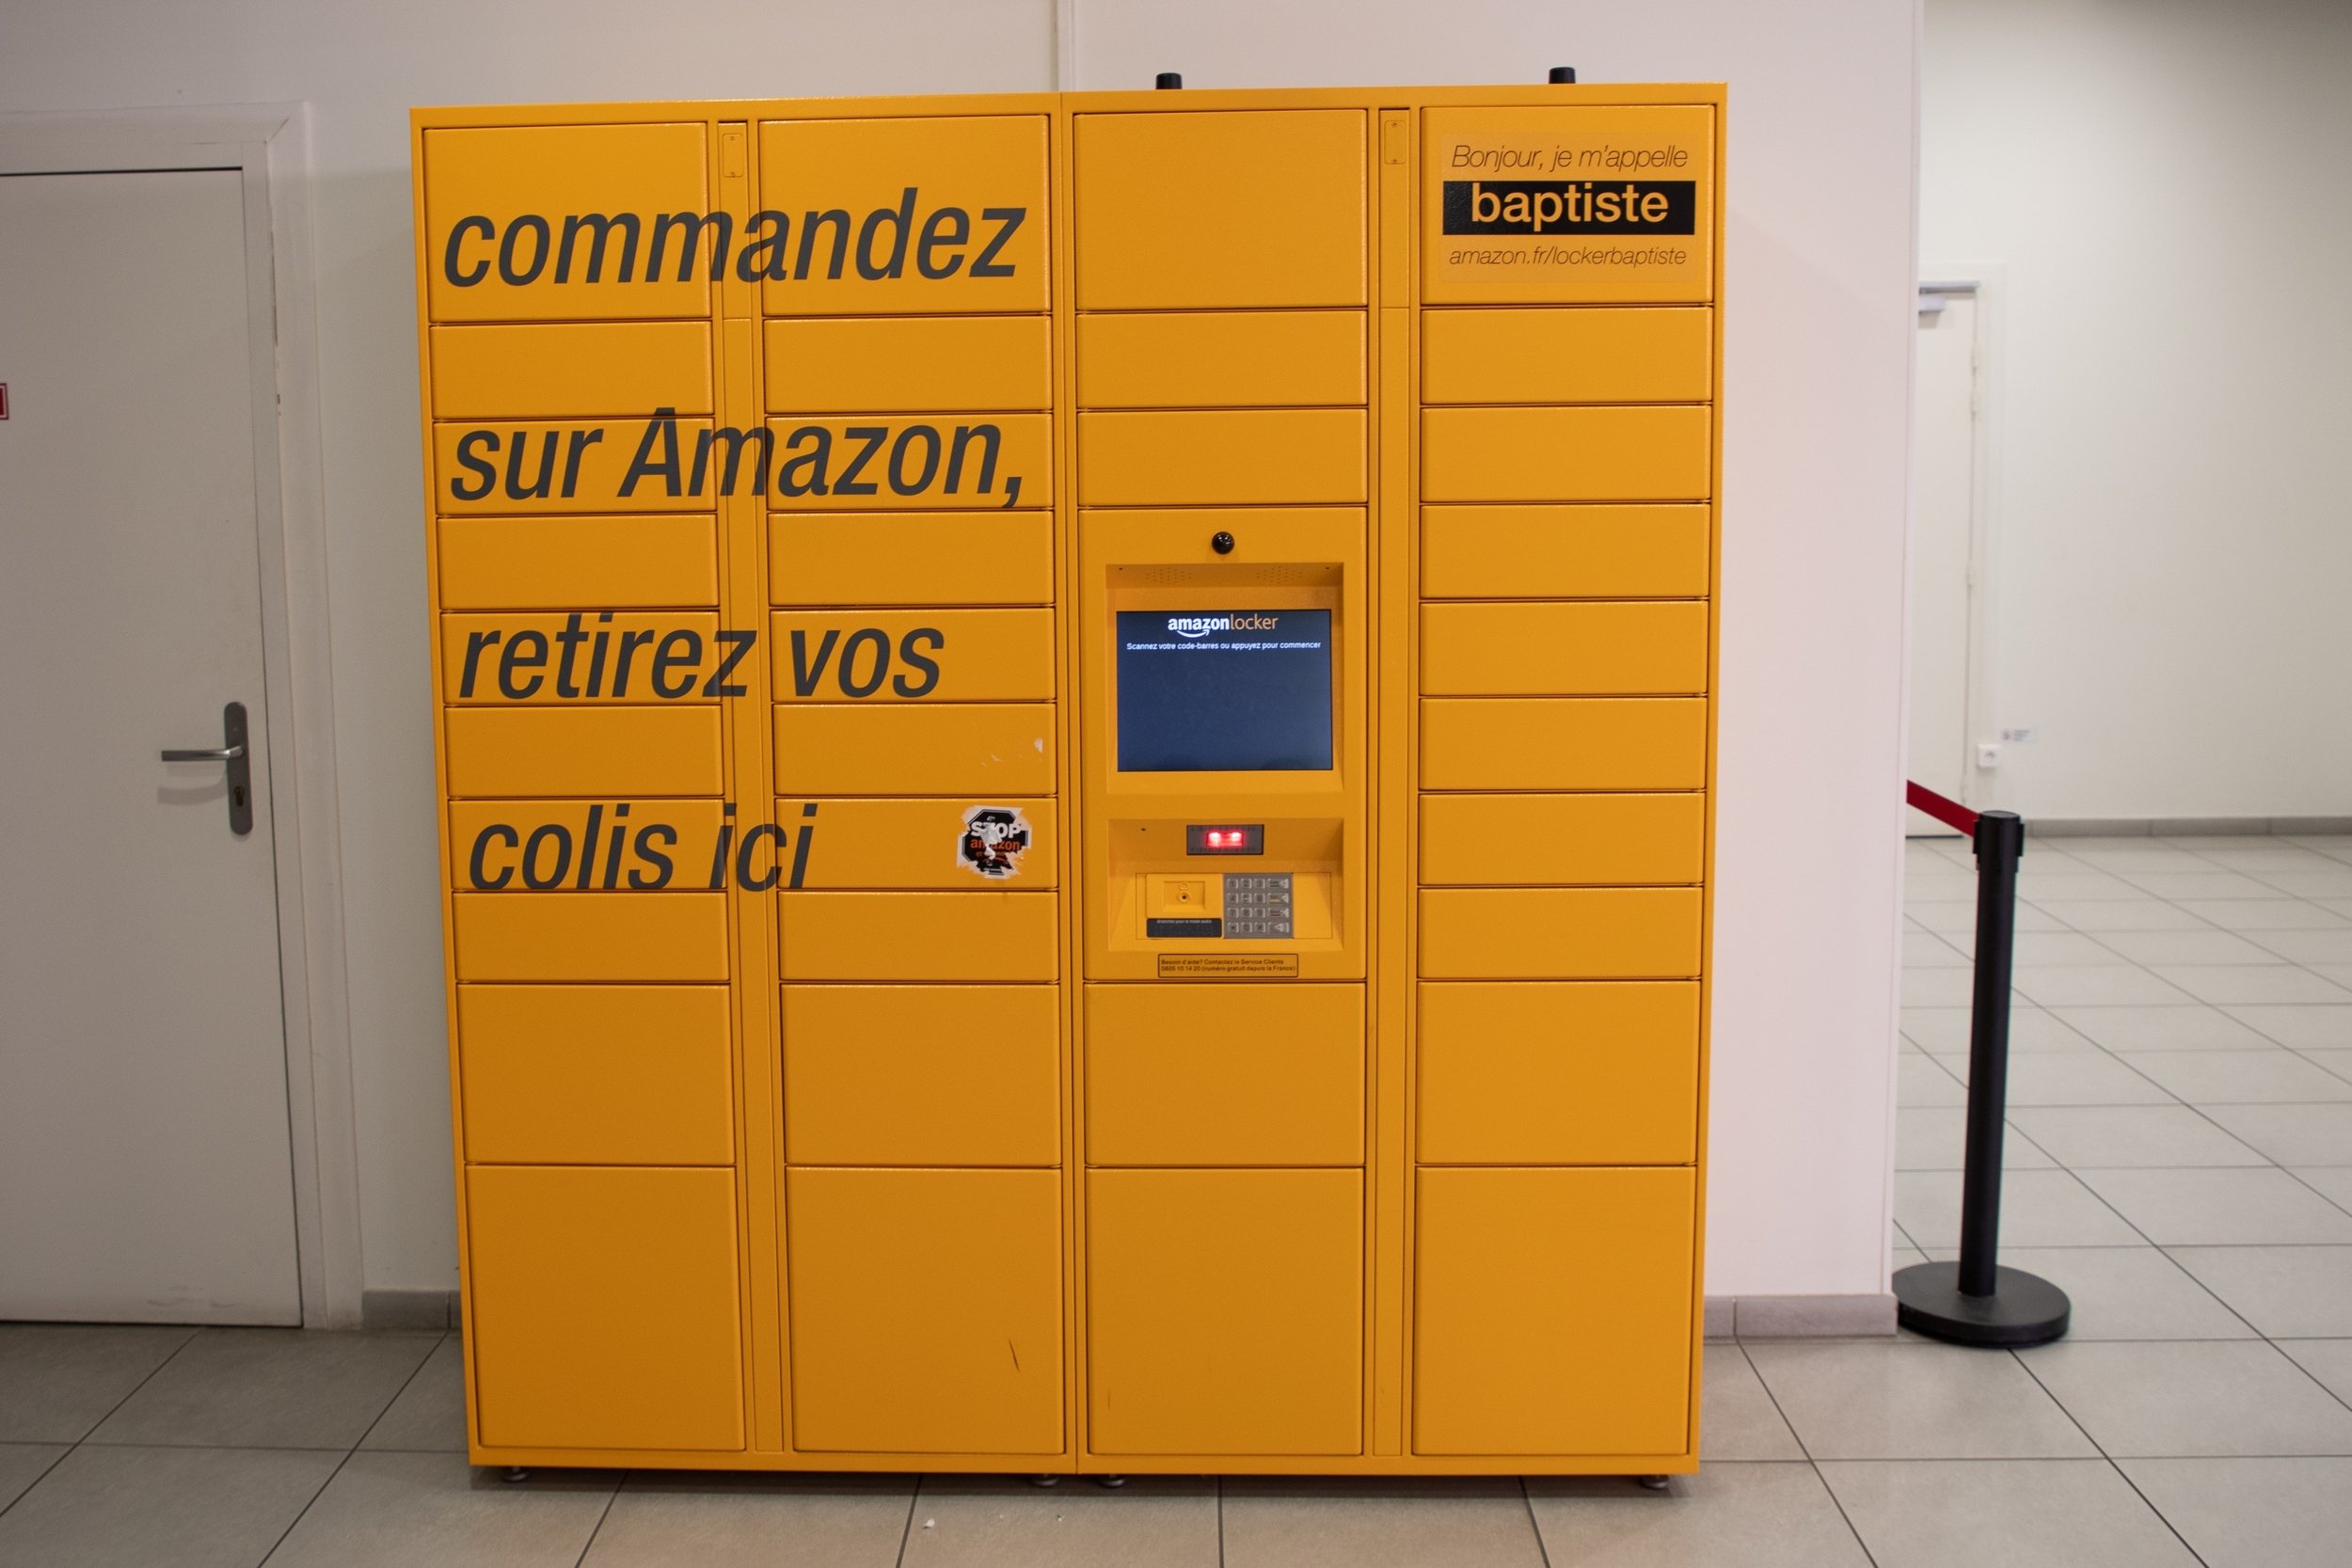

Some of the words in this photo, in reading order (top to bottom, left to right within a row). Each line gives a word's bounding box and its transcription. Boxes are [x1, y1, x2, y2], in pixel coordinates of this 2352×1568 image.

[1452, 145, 1544, 172] Bonjour,
[1549, 145, 1573, 172] je
[1578, 145, 1689, 172] m'appelle
[444, 187, 1026, 288] commandez
[1471, 182, 1669, 232] baptiste
[1449, 245, 1687, 268] amazon.fr/lockerbaptiste
[451, 428, 603, 501] sur
[617, 406, 1022, 510] Amazon,
[459, 609, 756, 700] retirez
[790, 627, 945, 699] vos
[1177, 641, 1218, 650] code-barres
[1231, 642, 1261, 651] appuyez
[1262, 642, 1279, 651] pour
[469, 803, 676, 890] colis
[709, 802, 818, 892] ici
